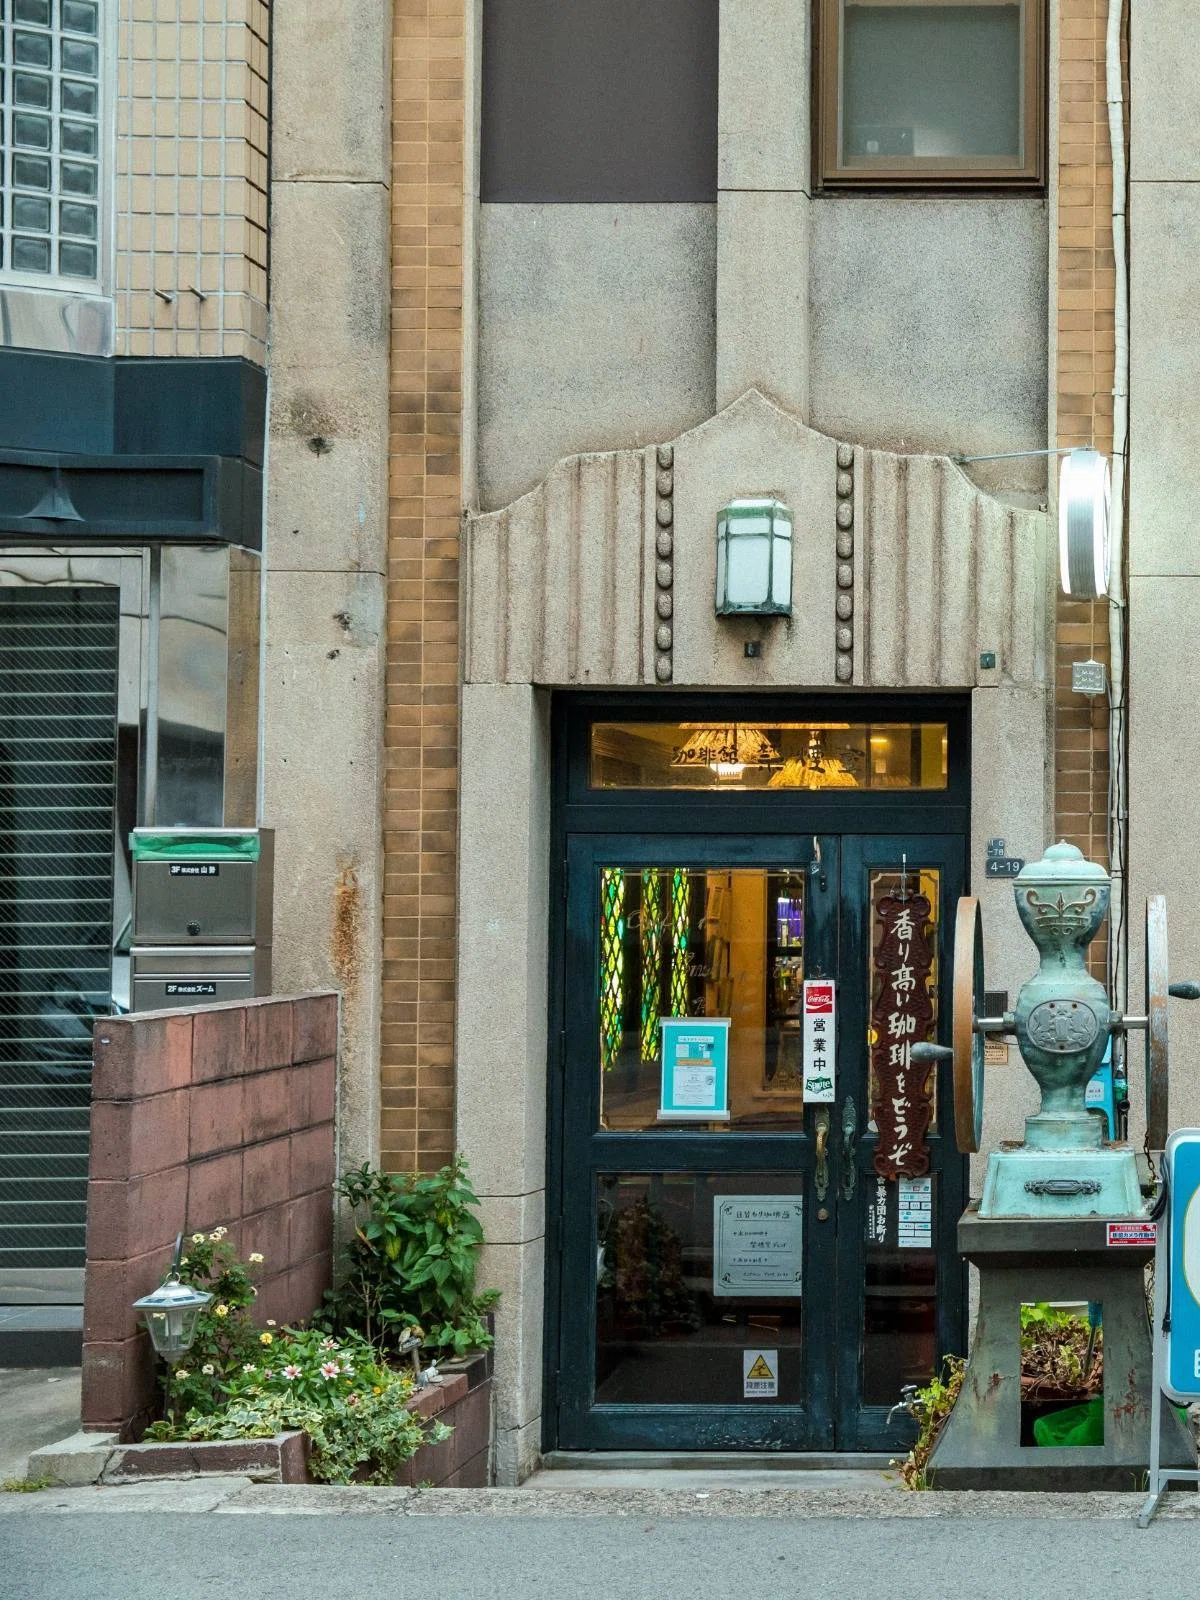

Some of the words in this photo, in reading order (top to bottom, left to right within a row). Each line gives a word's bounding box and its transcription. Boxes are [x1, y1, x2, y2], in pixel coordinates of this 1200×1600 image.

[991, 862, 1020, 872] 4-19
[813, 1018, 826, 1072] 営業中
